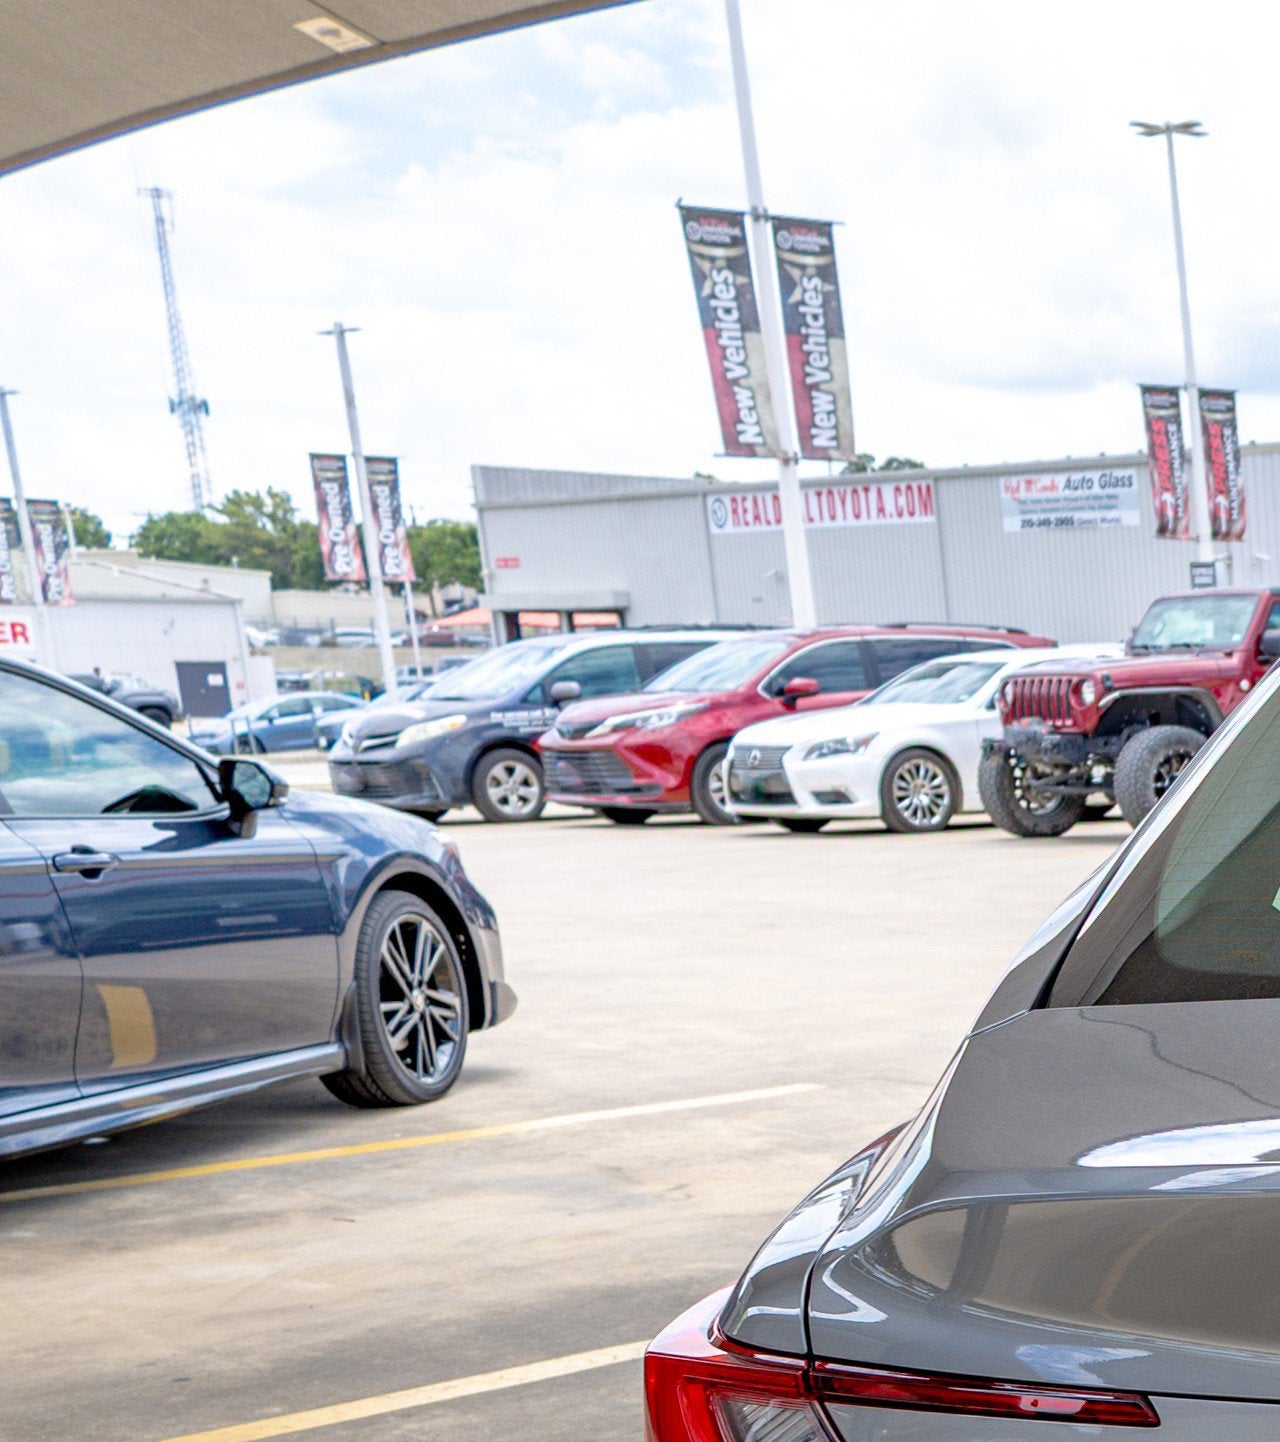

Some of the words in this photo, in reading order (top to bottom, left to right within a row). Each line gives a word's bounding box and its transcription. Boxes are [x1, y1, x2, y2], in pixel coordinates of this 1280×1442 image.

[710, 268, 748, 380] Vehicles
[798, 275, 832, 385] Vehicles
[733, 385, 764, 445] New
[809, 390, 838, 447] New
[730, 482, 935, 528] REALDLTOYOTA.COM
[1063, 475, 1094, 491] Auto
[1098, 470, 1134, 489] Glass
[1166, 421, 1185, 518] MAINTENANCE
[1222, 424, 1240, 520] MAINTENANCE
